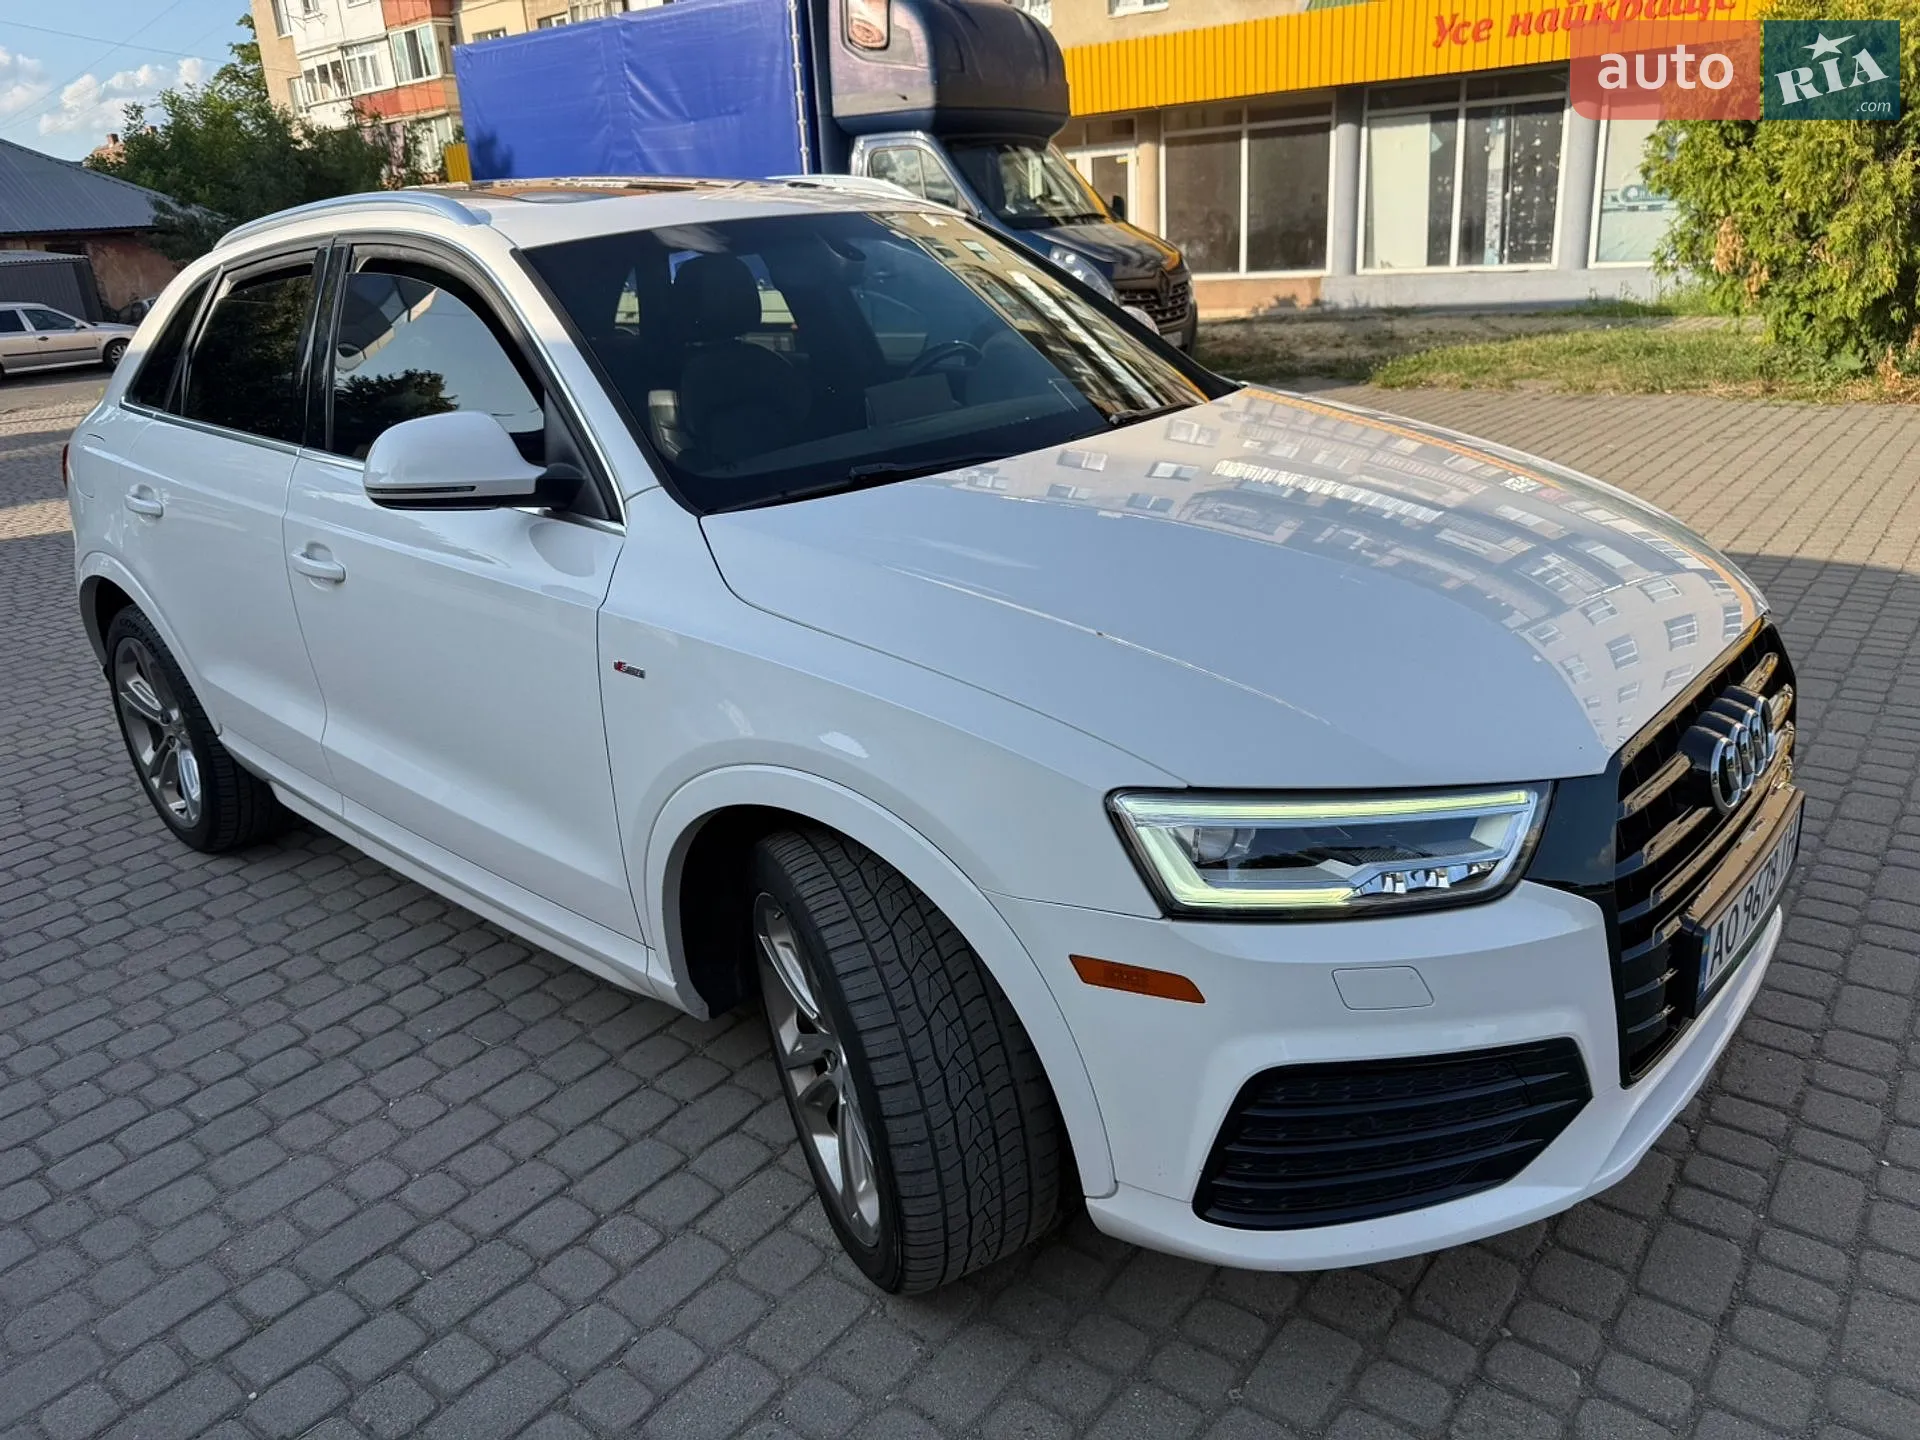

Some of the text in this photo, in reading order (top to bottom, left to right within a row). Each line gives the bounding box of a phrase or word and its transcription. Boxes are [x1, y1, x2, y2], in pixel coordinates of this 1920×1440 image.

[1433, 13, 1494, 49] Усе
[1709, 903, 1739, 978] AO
[1742, 847, 1780, 937] 9678
